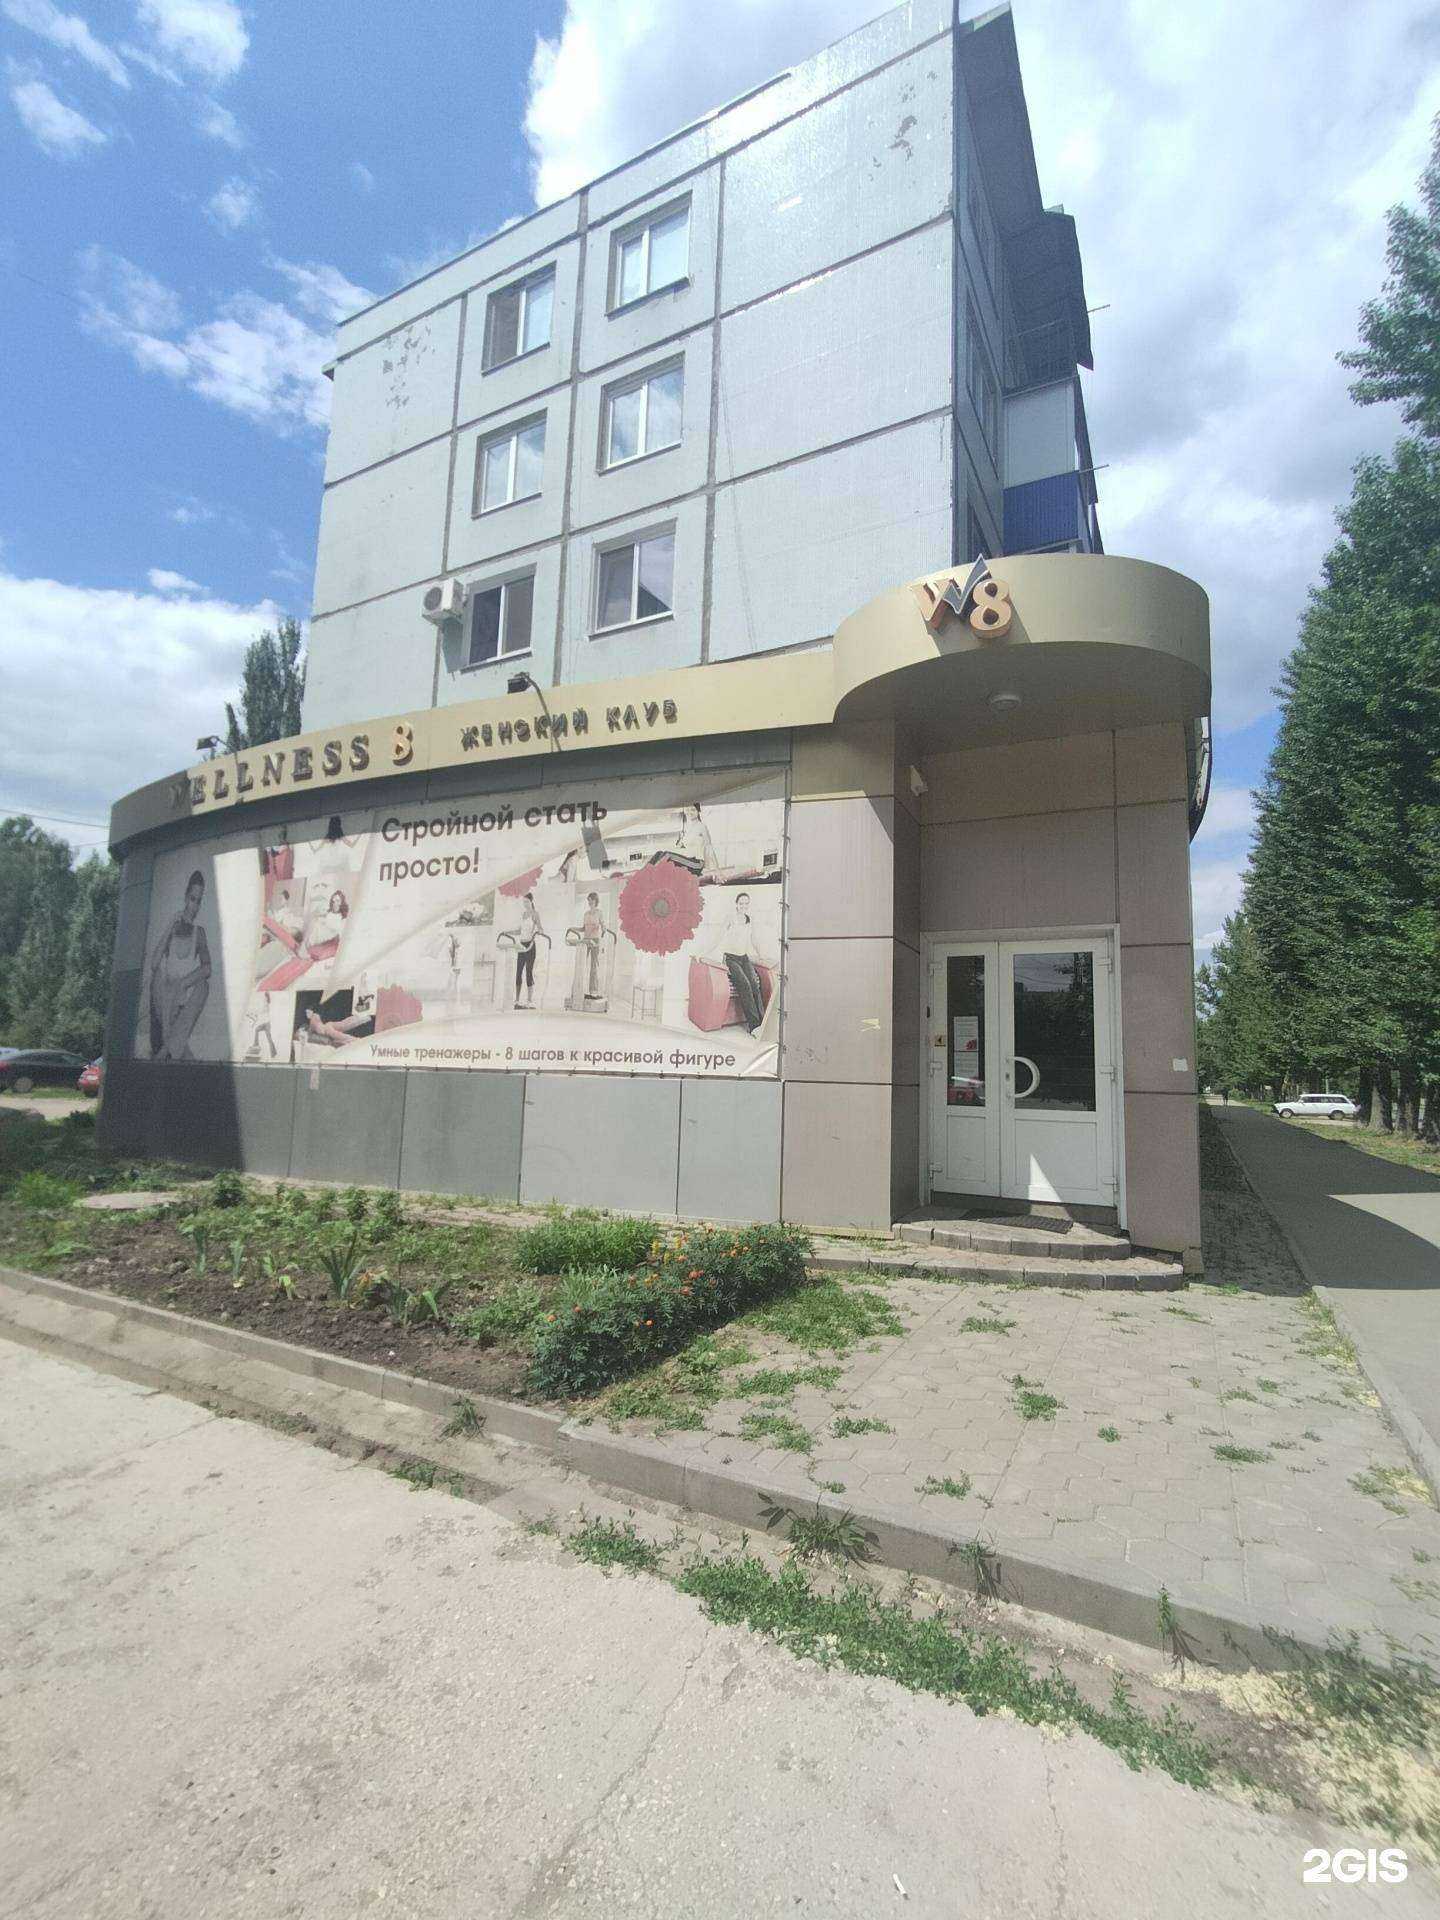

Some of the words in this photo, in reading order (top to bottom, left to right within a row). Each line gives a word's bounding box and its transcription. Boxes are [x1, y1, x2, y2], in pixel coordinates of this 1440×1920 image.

[460, 706, 589, 752] ЖЕНСКИЙ
[606, 699, 678, 733] КЛУБ
[168, 734, 370, 811] WELLNESS
[390, 720, 413, 766] 8
[381, 804, 513, 847] Стройной
[524, 800, 608, 827] стать
[379, 847, 480, 887] просто!
[370, 1044, 410, 1058] Умные
[415, 1047, 491, 1062] тренажеры
[505, 1046, 513, 1060] 8
[518, 1047, 565, 1061] шагов
[570, 1050, 578, 1061] к
[584, 1049, 663, 1064] красивой
[669, 1048, 736, 1069] фигуре
